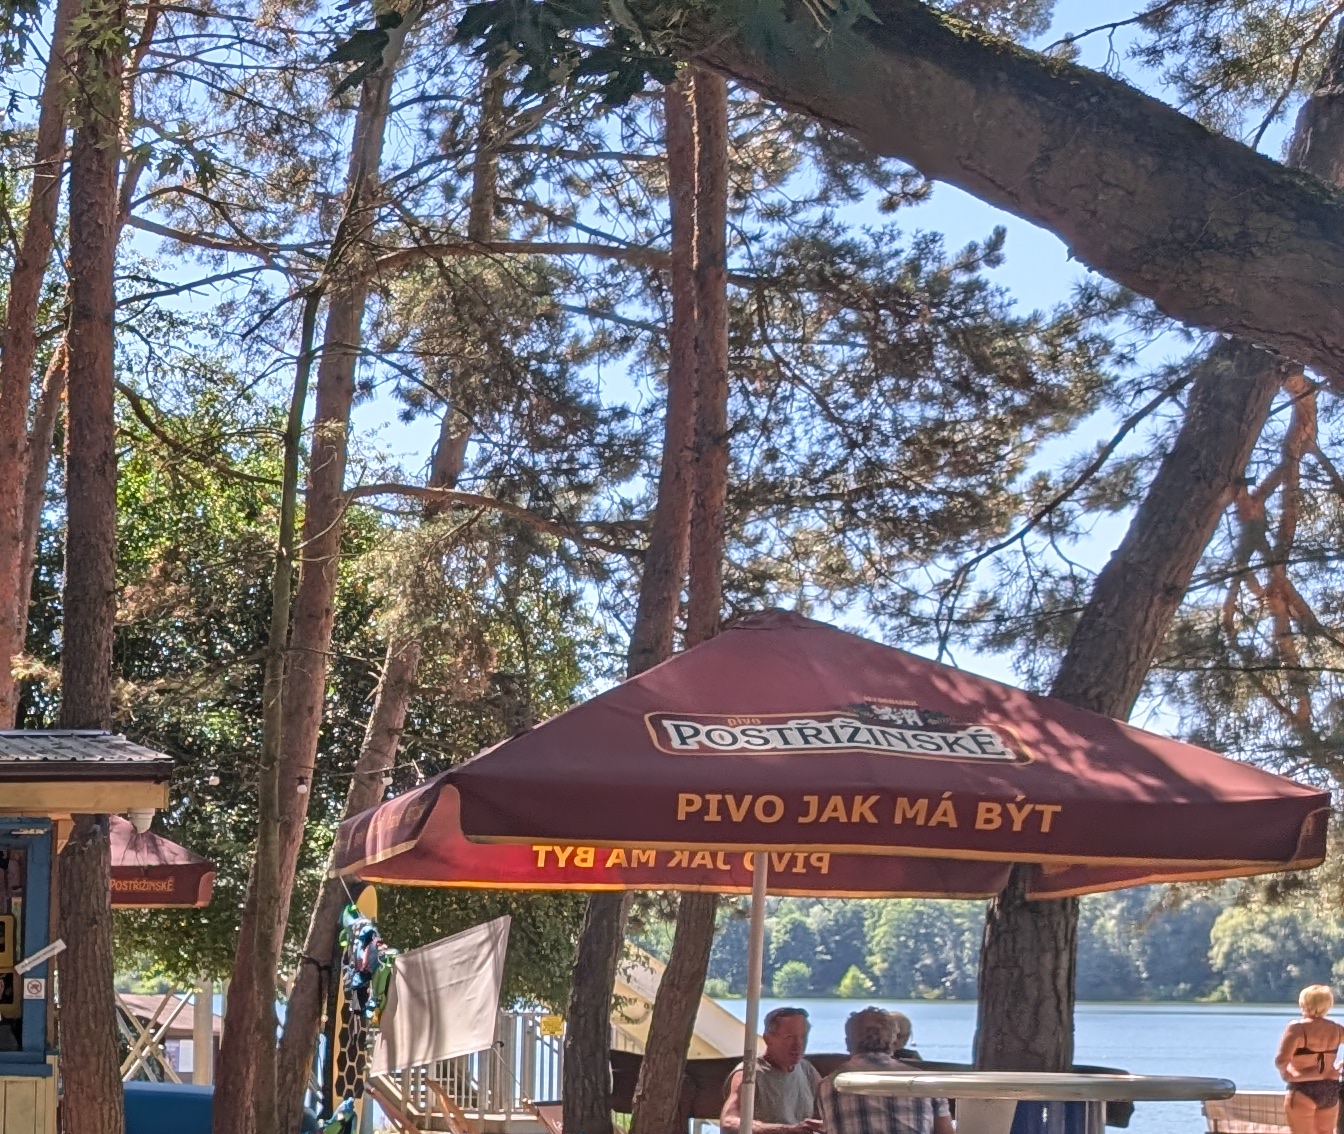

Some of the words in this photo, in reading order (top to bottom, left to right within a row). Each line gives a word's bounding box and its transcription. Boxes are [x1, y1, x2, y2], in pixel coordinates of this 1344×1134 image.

[669, 717, 1010, 759] POSTŘIŽINSKÉ
[676, 792, 785, 824] PIVO
[798, 795, 880, 825] JAK
[893, 791, 959, 828] MÁ
[975, 793, 1063, 834] BÝT
